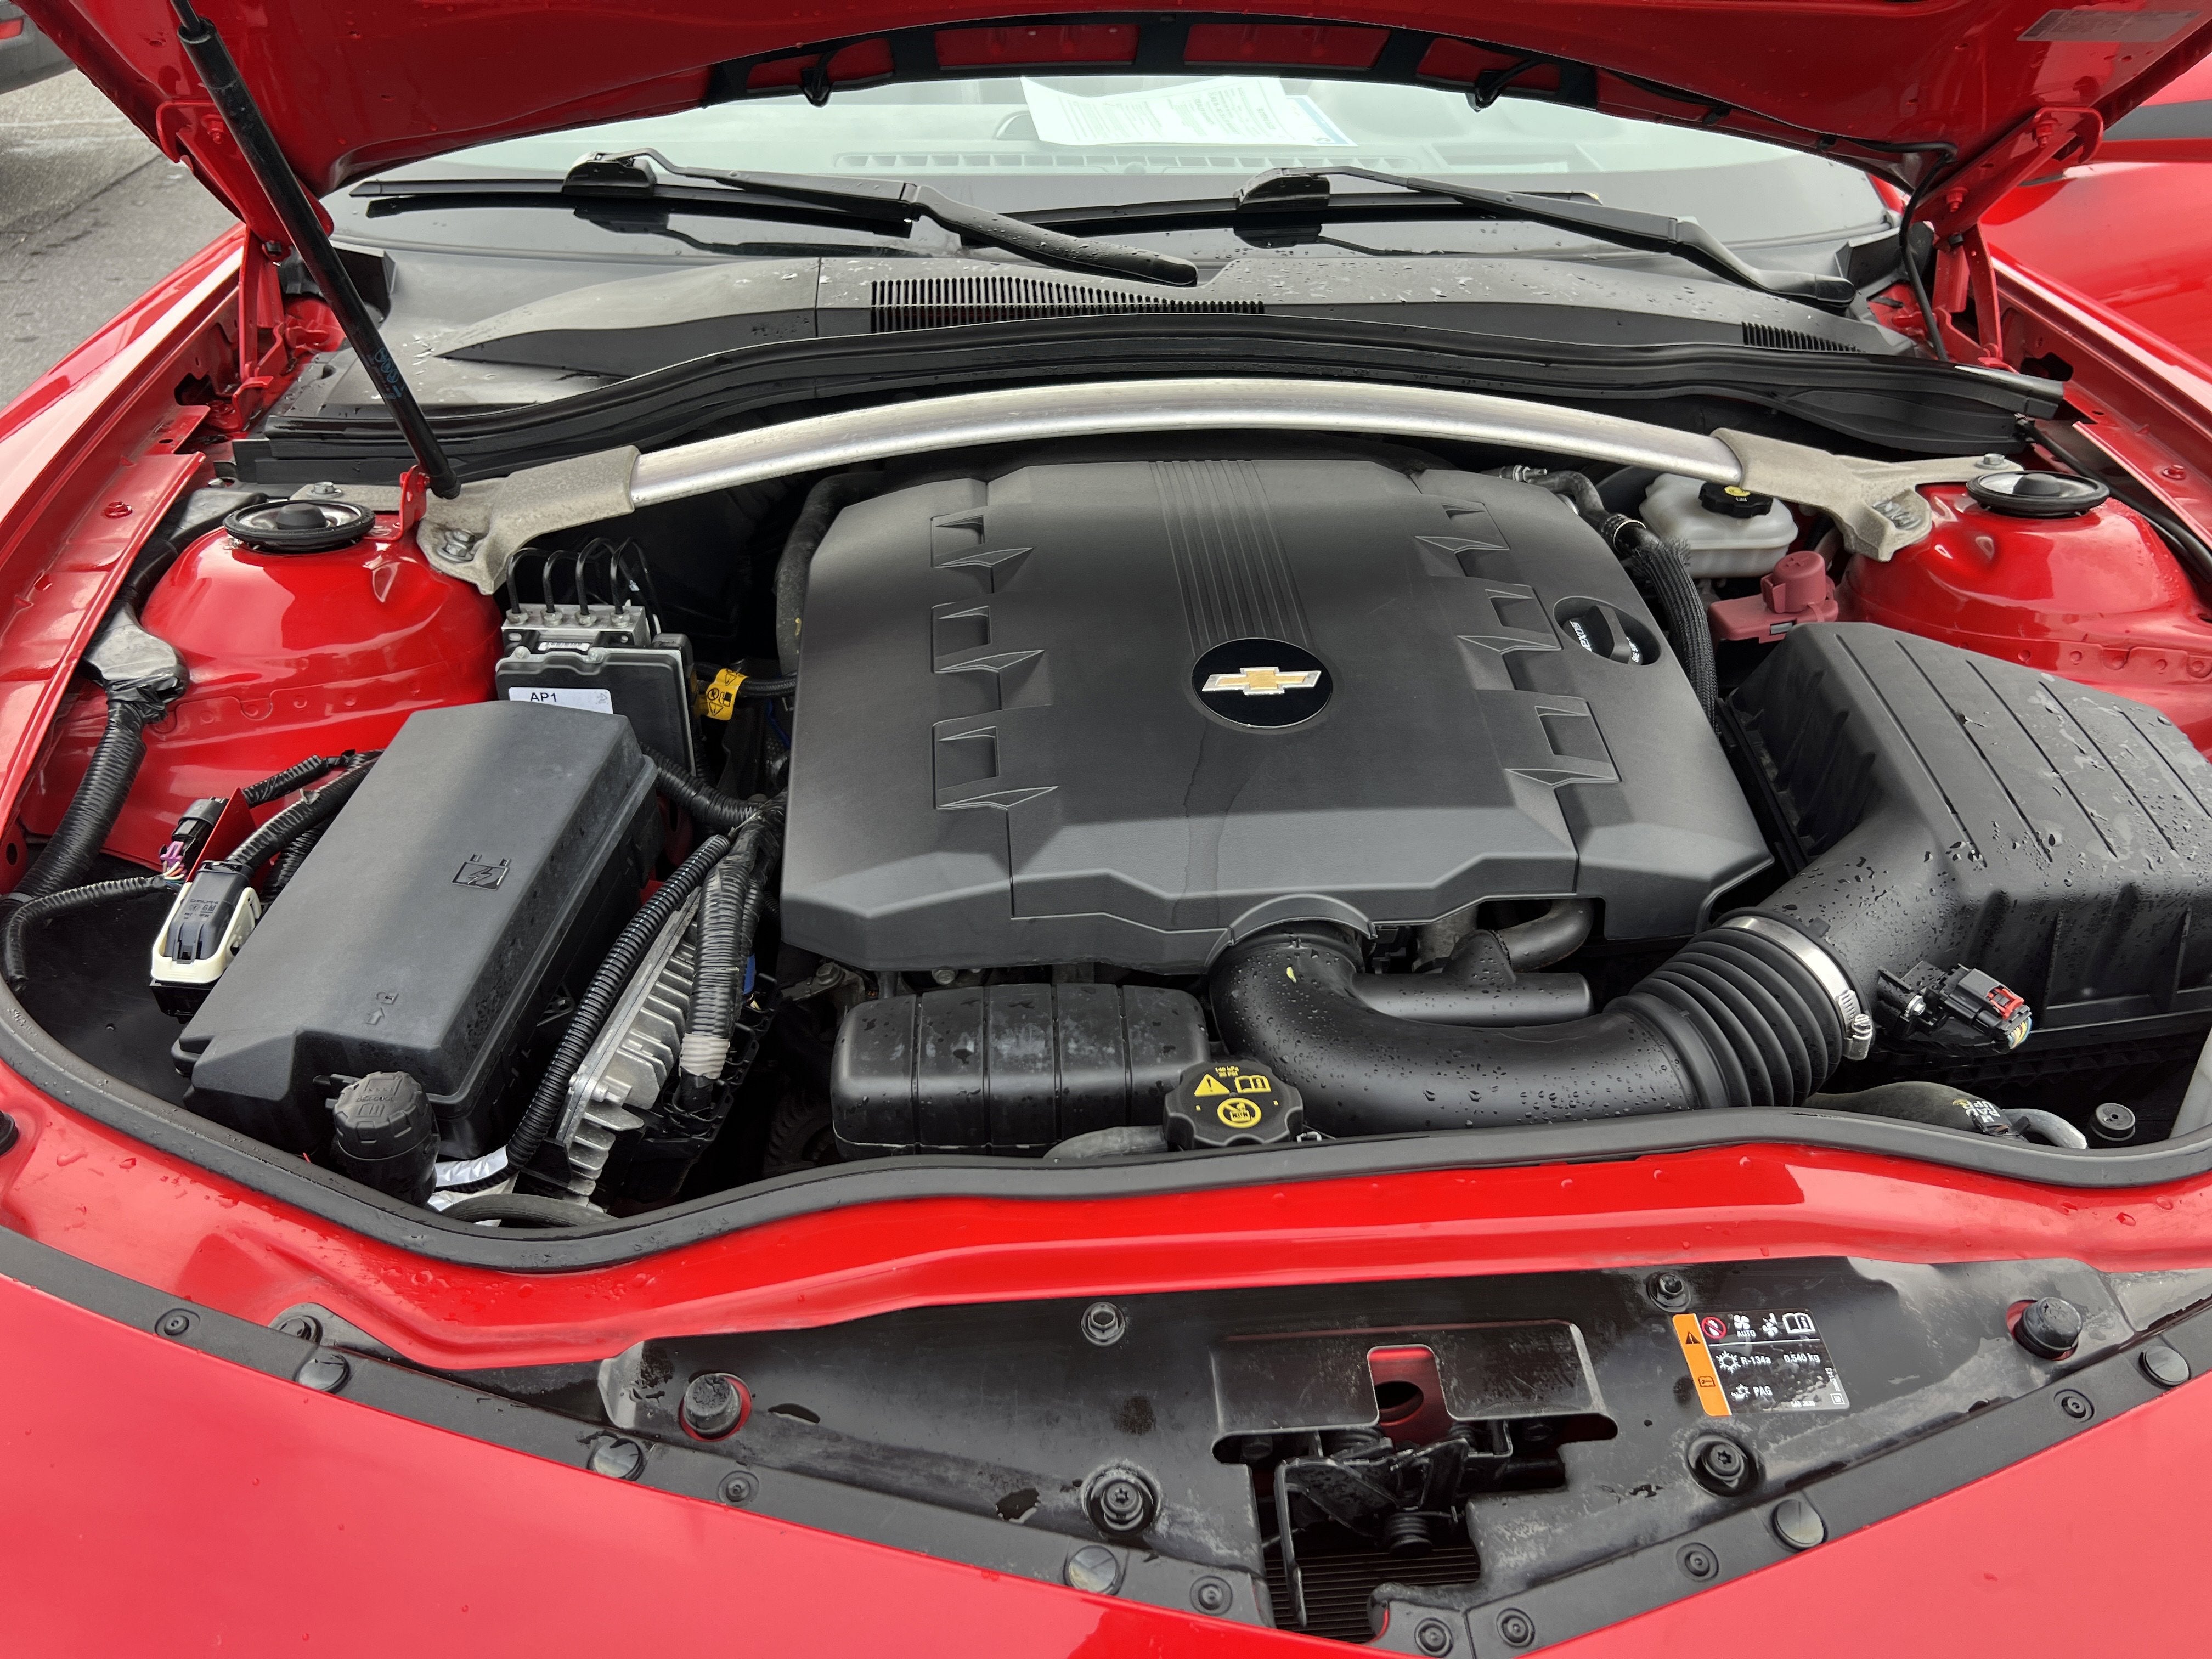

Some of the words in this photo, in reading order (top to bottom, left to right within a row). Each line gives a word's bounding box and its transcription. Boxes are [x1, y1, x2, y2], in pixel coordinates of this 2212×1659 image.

[530, 692, 557, 702] AP1
[1740, 1355, 1771, 1365] R-134a
[1784, 1353, 1807, 1363] 0.540
[1807, 1353, 1820, 1363] kg
[1752, 1386, 1772, 1396] PAG
